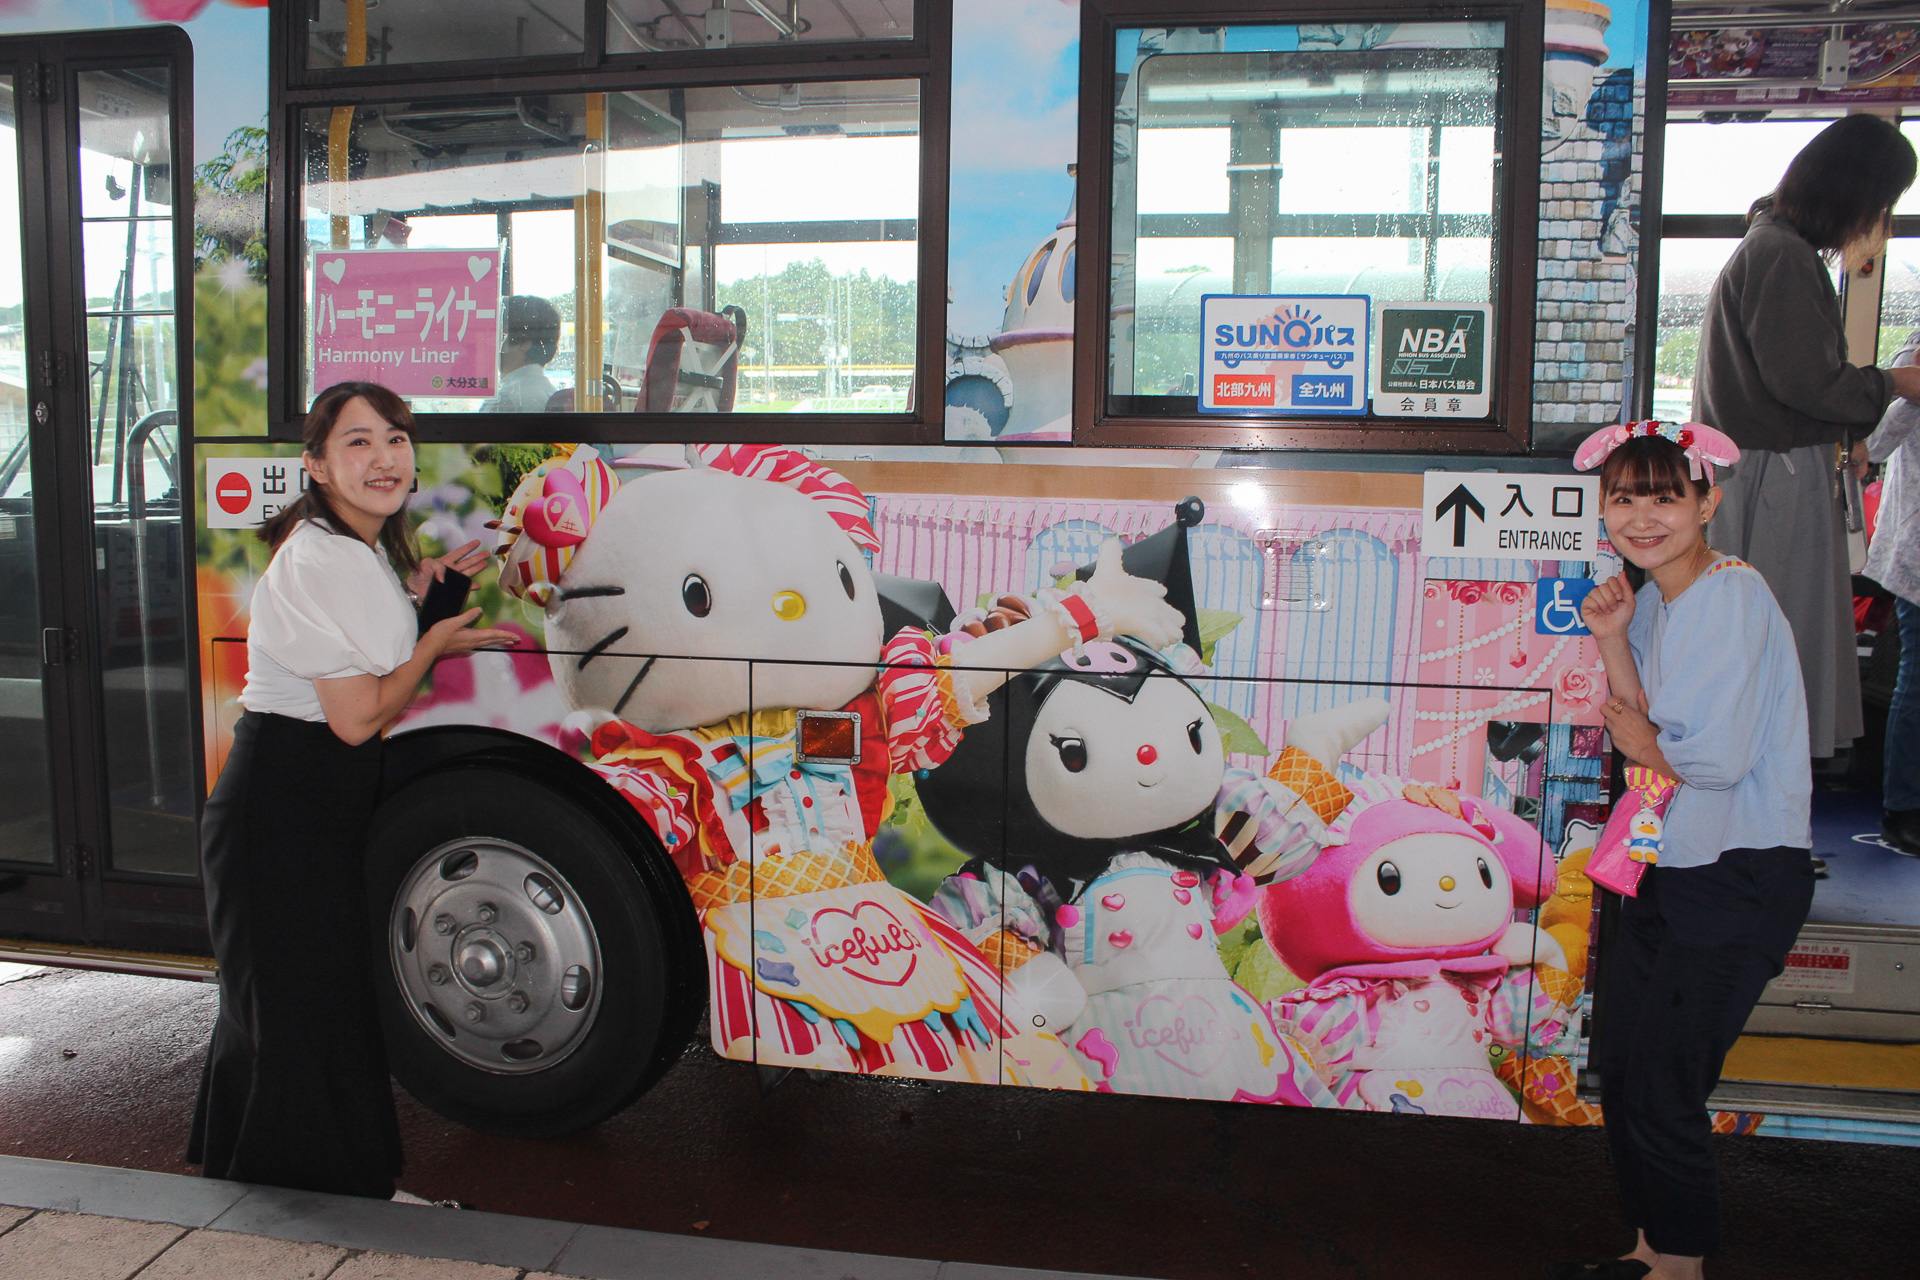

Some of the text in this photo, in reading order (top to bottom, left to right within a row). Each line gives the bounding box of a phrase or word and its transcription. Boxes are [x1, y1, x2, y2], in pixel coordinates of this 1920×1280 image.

[317, 286, 496, 342] ハーモニーライナー
[1398, 328, 1467, 353] NBA
[318, 347, 460, 367] Harmony Liner
[446, 377, 489, 389] 大分交通
[1216, 382, 1271, 397] 北部九州
[1298, 382, 1345, 398] 全九州
[1419, 379, 1476, 390] 日本バス協会
[1500, 484, 1584, 518] 入口
[1498, 529, 1583, 551] ENTRANCE
